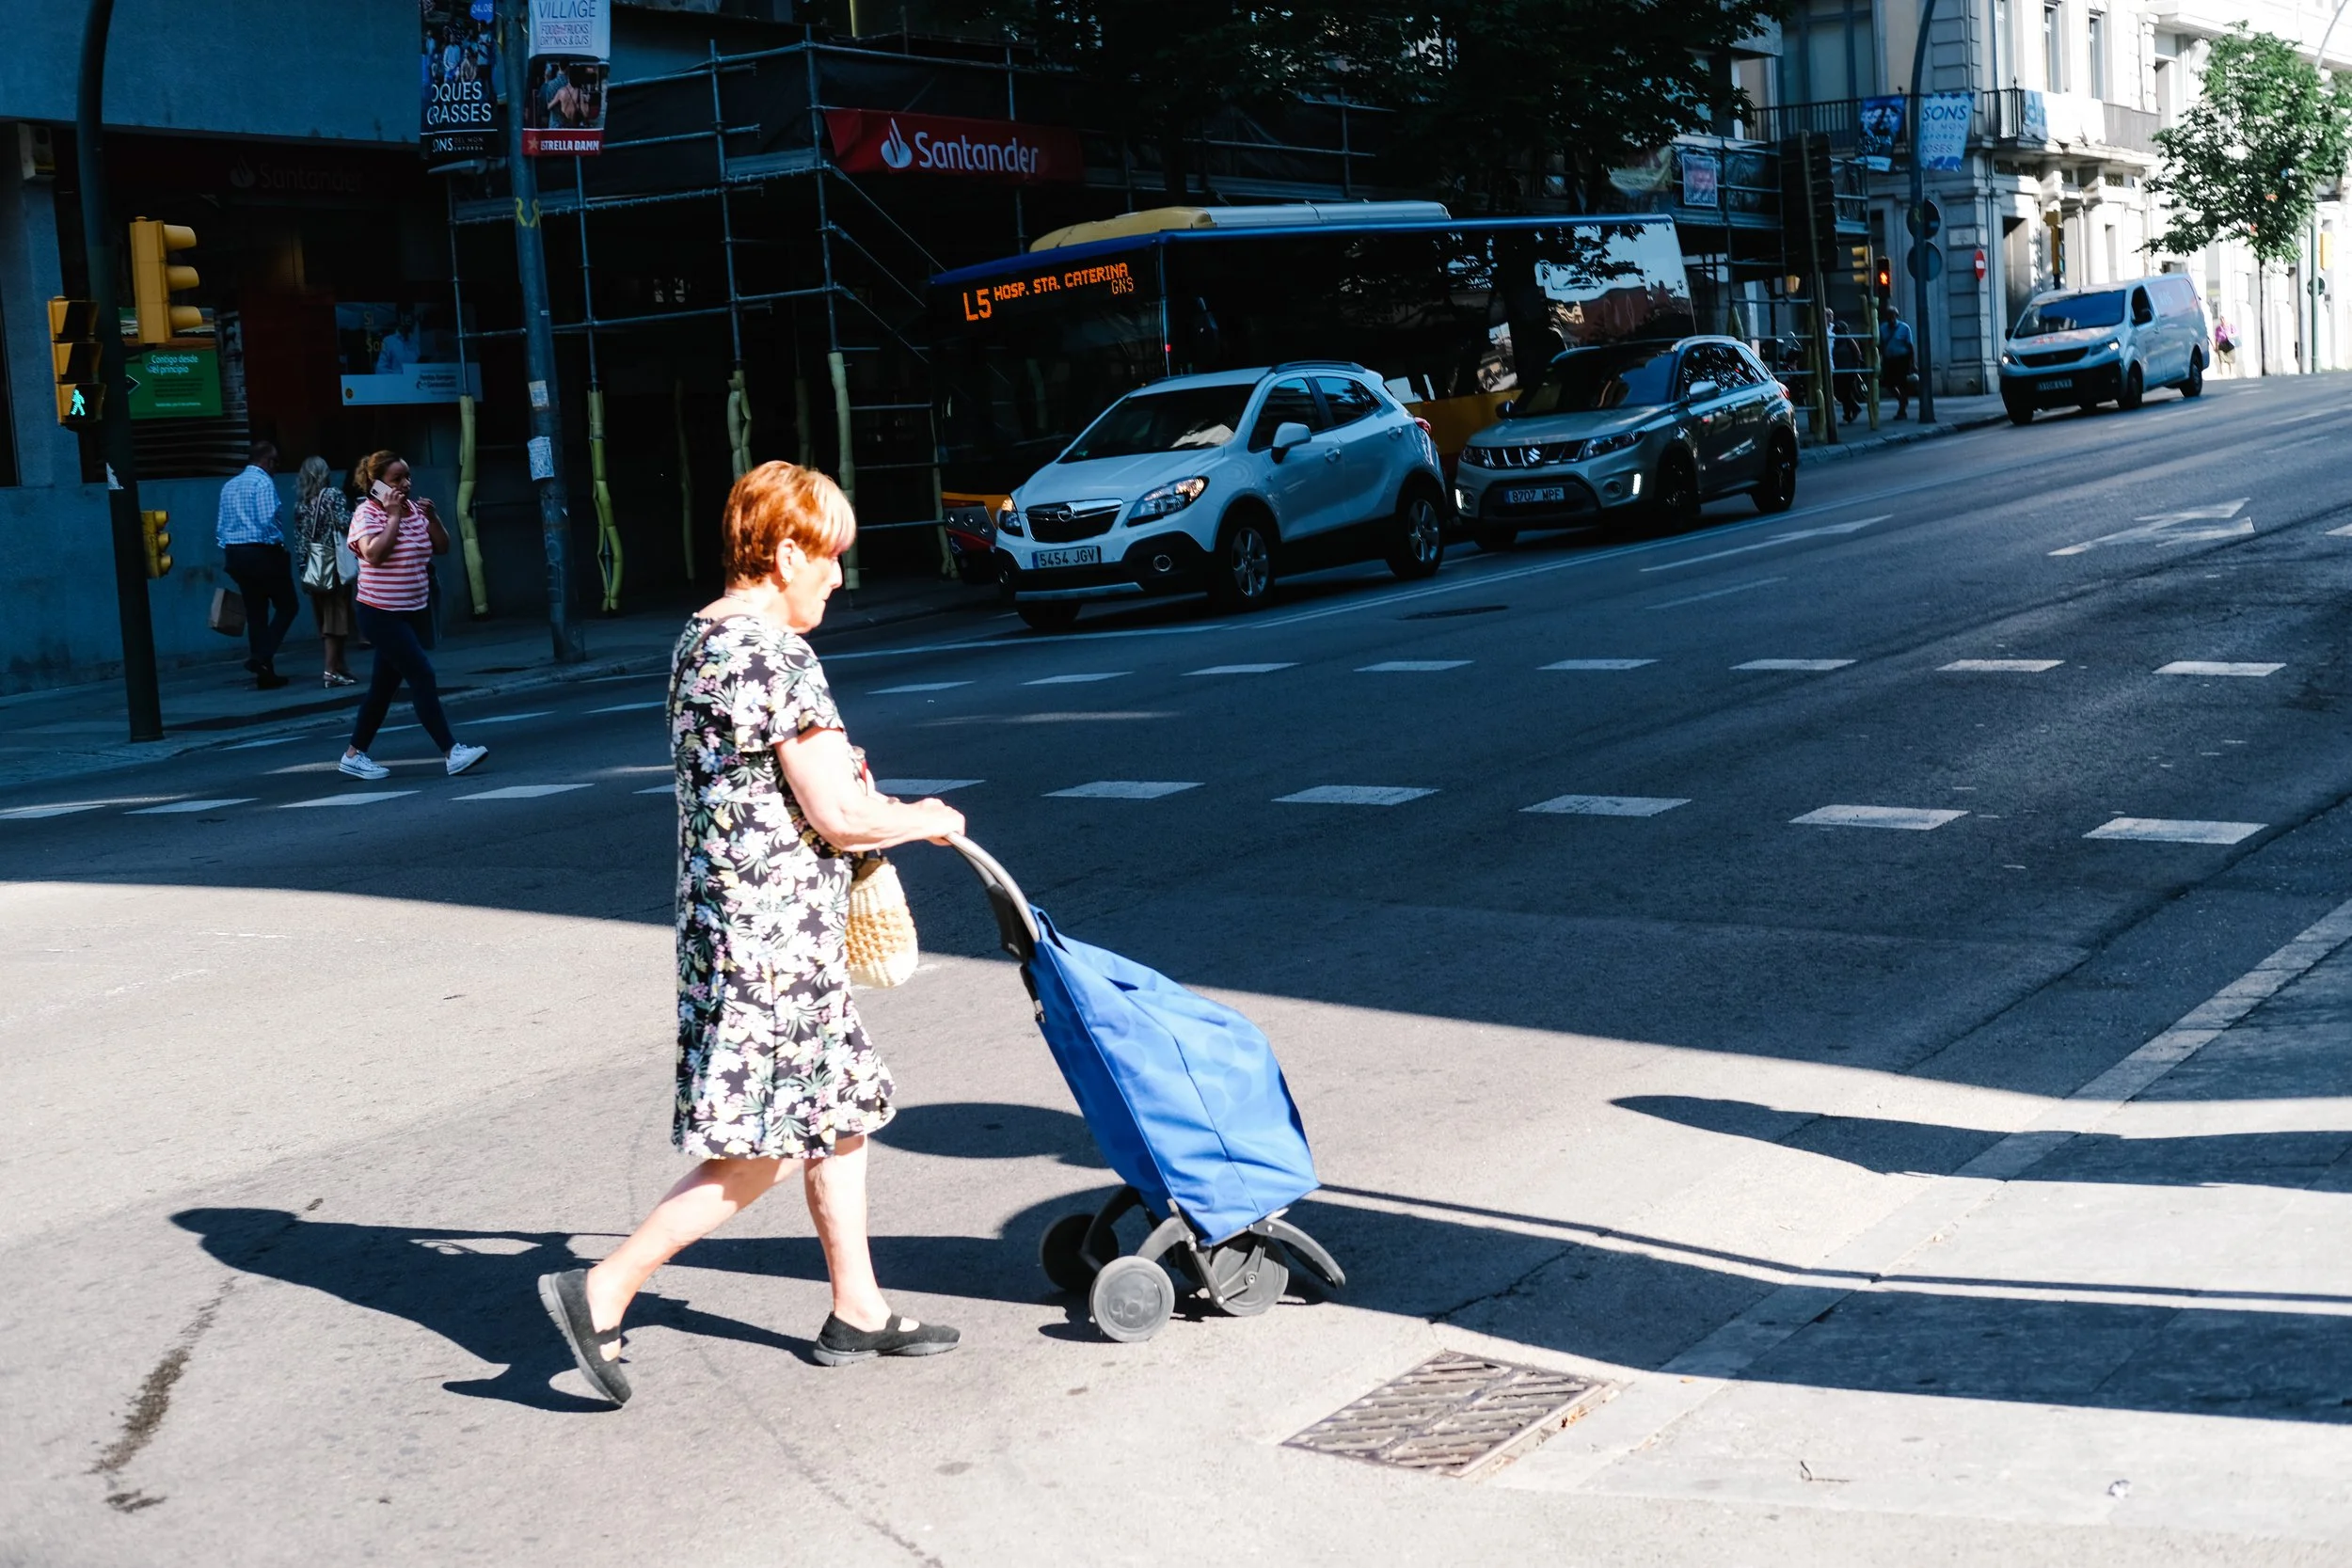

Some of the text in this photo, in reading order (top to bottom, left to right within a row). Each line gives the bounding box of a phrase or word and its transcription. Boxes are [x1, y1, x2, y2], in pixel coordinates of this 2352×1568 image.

[539, 0, 596, 18] VILLAGE
[1922, 104, 1967, 121] SONS
[432, 137, 453, 153] ONS
[914, 132, 1039, 173] Santander
[260, 162, 363, 193] Santander
[962, 262, 1129, 322] L5 HOSP. STA. CATERINA
[1111, 277, 1135, 295] GNS
[1512, 489, 1536, 502] 8707
[1040, 547, 1094, 566] 5454 JGV
